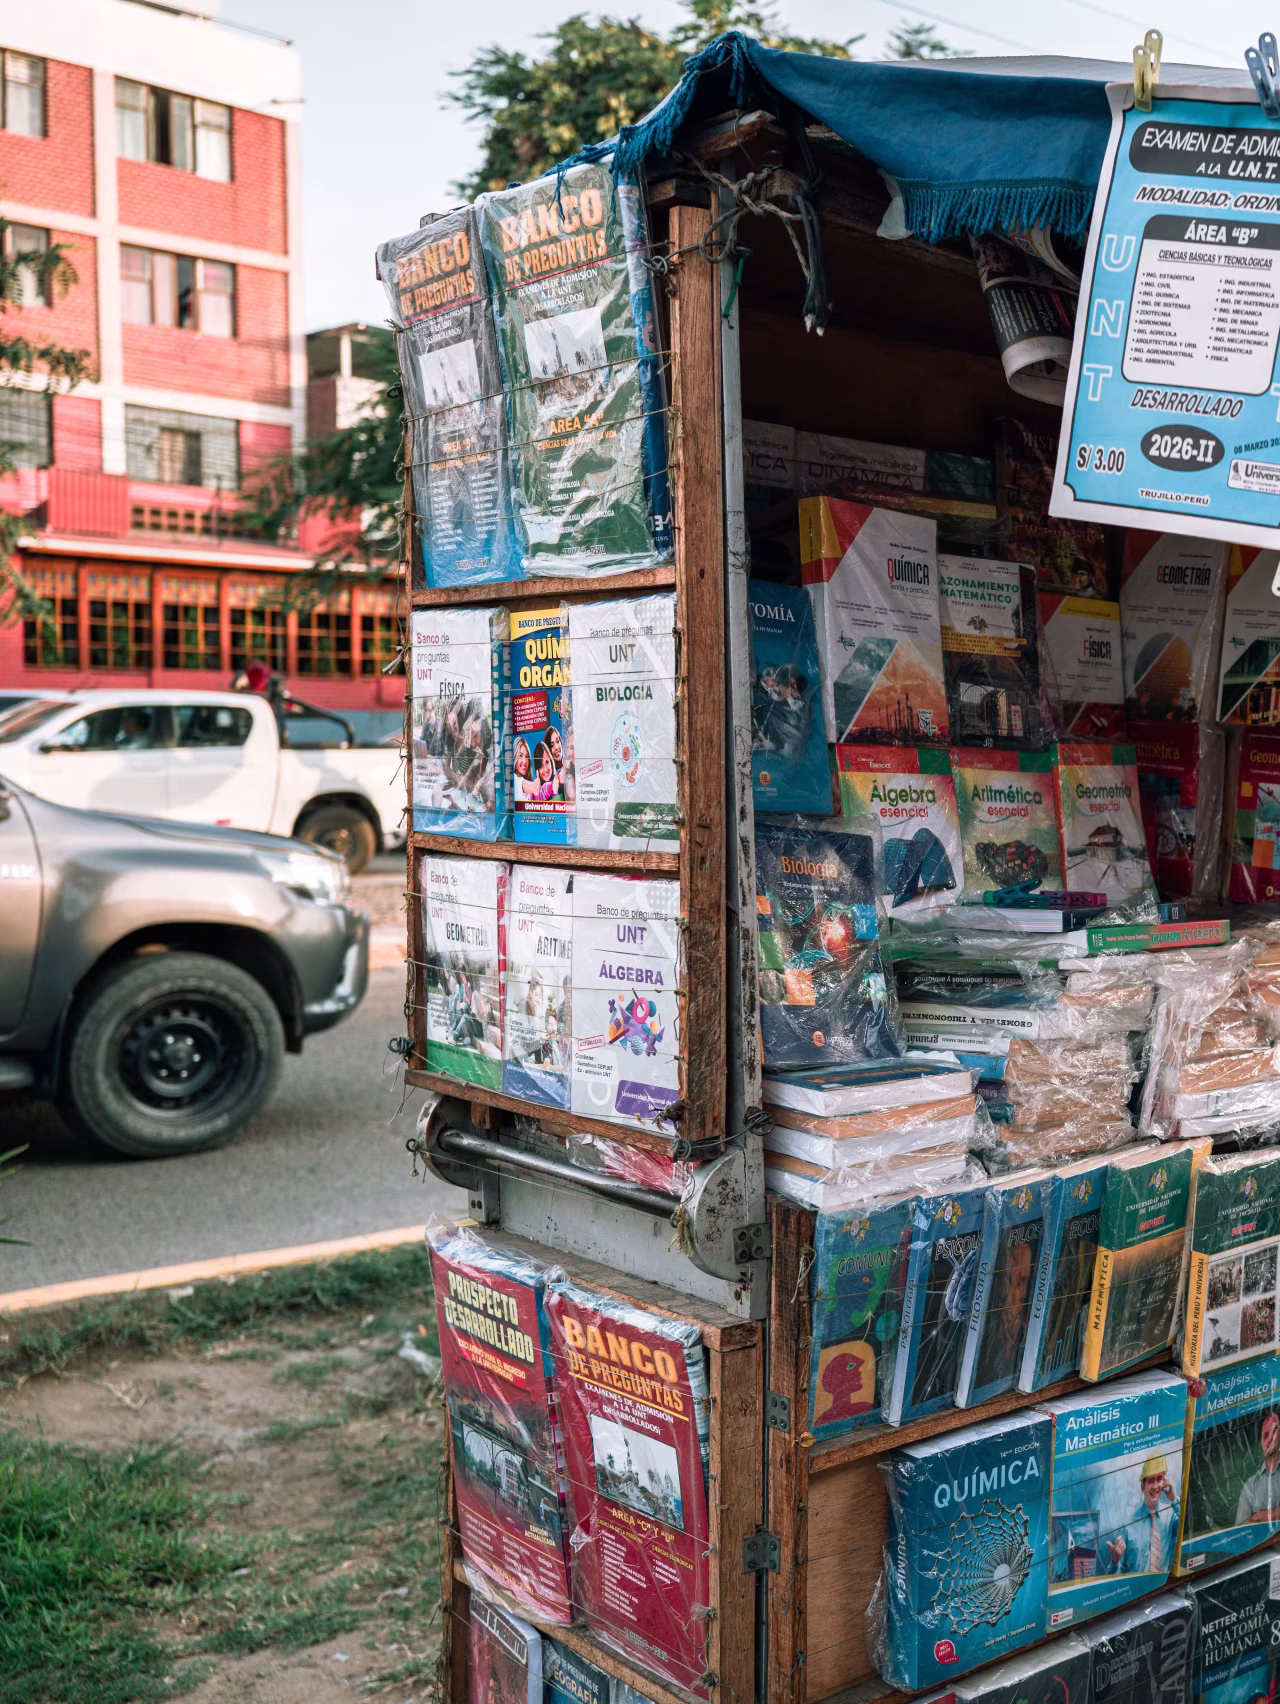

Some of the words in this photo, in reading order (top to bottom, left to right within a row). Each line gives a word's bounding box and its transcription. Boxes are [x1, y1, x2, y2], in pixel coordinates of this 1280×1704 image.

[1142, 128, 1210, 152] EXAMEN
[1212, 134, 1236, 154] DE
[1196, 163, 1207, 173] A
[1208, 164, 1221, 175] LA
[1228, 160, 1278, 179] U.N.T.
[1136, 187, 1230, 207] MODALIDAD:
[500, 188, 602, 253] BANCO
[1184, 220, 1226, 242] ÁREA
[505, 257, 521, 282] DE
[523, 230, 606, 278] PREGUNTAS
[1159, 250, 1188, 261] CIENCIAS
[1188, 252, 1215, 263] BÁSICAS
[1217, 255, 1222, 263] Y
[1223, 254, 1272, 268] TECNOLÓGICAS
[1159, 272, 1195, 281] ESTADÍSTICA
[1138, 319, 1171, 327] AGRONOMIA
[1131, 388, 1243, 418] DESARROLLADO
[1077, 445, 1092, 468] S/
[1094, 448, 1125, 473] 3.00
[1149, 434, 1216, 463] 2026-II
[1234, 446, 1242, 454] 08
[1244, 440, 1269, 453] MARZO
[1140, 490, 1210, 505] TRUJILLO-PERÚ
[887, 555, 930, 586] QUÍMICA
[1157, 565, 1211, 586] GEOMETRÍA
[940, 576, 1019, 593] AZONAMIENTO
[941, 586, 1012, 604] MATEMÁTICO
[609, 643, 636, 663] UNT
[1083, 636, 1112, 659] FÍSICA
[439, 680, 466, 701] FÍSICA
[596, 682, 653, 701] BIOLOGÍA
[870, 780, 936, 808] Álgebra
[971, 784, 1042, 806] Aritmética
[1076, 782, 1131, 801] Geometría
[781, 855, 838, 880] Biología
[597, 904, 618, 916] Banco
[620, 907, 629, 916] de
[632, 909, 668, 921] preguntas
[446, 921, 489, 947] GEOMETRÍA
[616, 924, 647, 944] UNT
[599, 960, 664, 986] ÁLGEBRA
[1033, 1242, 1052, 1319] ECONOMIA
[1093, 1253, 1109, 1331] MATEMÁTICA
[448, 1270, 518, 1326] PROSPECTO
[969, 1260, 989, 1333] FILOSOFIA
[444, 1298, 534, 1363] DESARROLLADO
[562, 1314, 678, 1383] BANCO
[568, 1350, 588, 1378] DE
[592, 1364, 683, 1411] PREGUNTAS
[1209, 1373, 1250, 1395] Análisis
[1207, 1384, 1269, 1412] Matemático
[1270, 1378, 1278, 1392] II
[1066, 1407, 1120, 1431] Análisis
[1066, 1421, 1144, 1452] Matemático
[1148, 1414, 1159, 1429] III
[934, 1455, 1040, 1508] QUÍMICA
[897, 1533, 906, 1604] QUÍMICA
[1201, 1613, 1237, 1636] NETTER
[1239, 1602, 1266, 1621] ATLAS
[1204, 1612, 1271, 1651] ANATOMÍA
[1205, 1634, 1262, 1667] HUMANA
